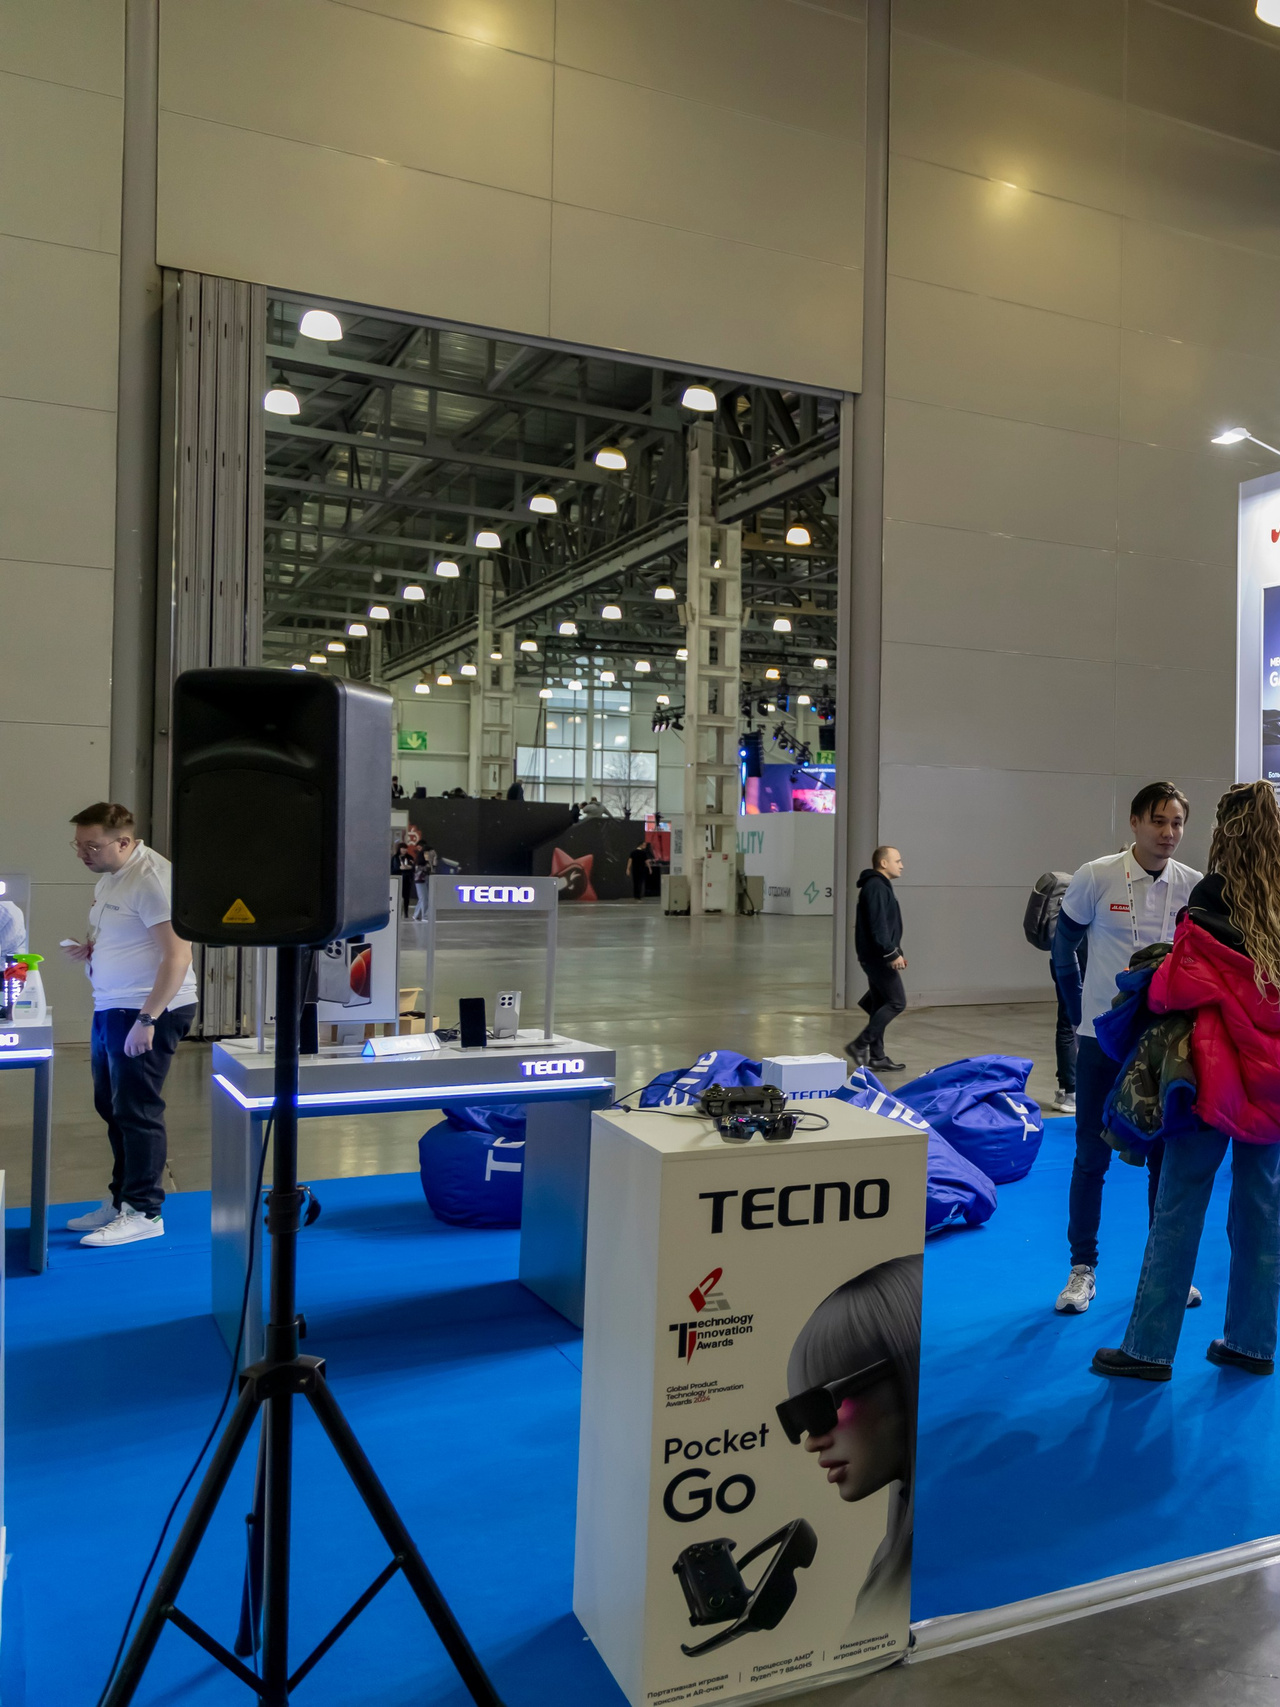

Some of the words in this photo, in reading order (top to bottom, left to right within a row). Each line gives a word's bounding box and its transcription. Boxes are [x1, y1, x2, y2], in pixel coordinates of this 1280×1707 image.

[458, 886, 535, 903] TECNO
[521, 1059, 584, 1076] TECNO
[699, 1178, 890, 1234] TECNO
[697, 1338, 734, 1350] Awards
[666, 1384, 689, 1393] Global
[690, 1380, 718, 1390] Product
[666, 1388, 707, 1401] Technology
[708, 1383, 744, 1394] Innovation
[665, 1398, 692, 1408] Awards
[693, 1395, 711, 1404] 2024
[664, 1423, 769, 1464] Pocket
[663, 1467, 756, 1523] Go
[833, 1648, 862, 1661] игровой
[863, 1644, 880, 1654] опыт
[887, 1639, 897, 1648] 6D
[840, 1633, 889, 1650] Иммерсивный
[753, 1658, 793, 1672] Процессор
[785, 1660, 812, 1673] 8840HS
[647, 1681, 697, 1698] Портативная
[698, 1673, 729, 1686] игровая
[653, 1694, 685, 1706] консоль
[693, 1684, 724, 1697] AR-очки
